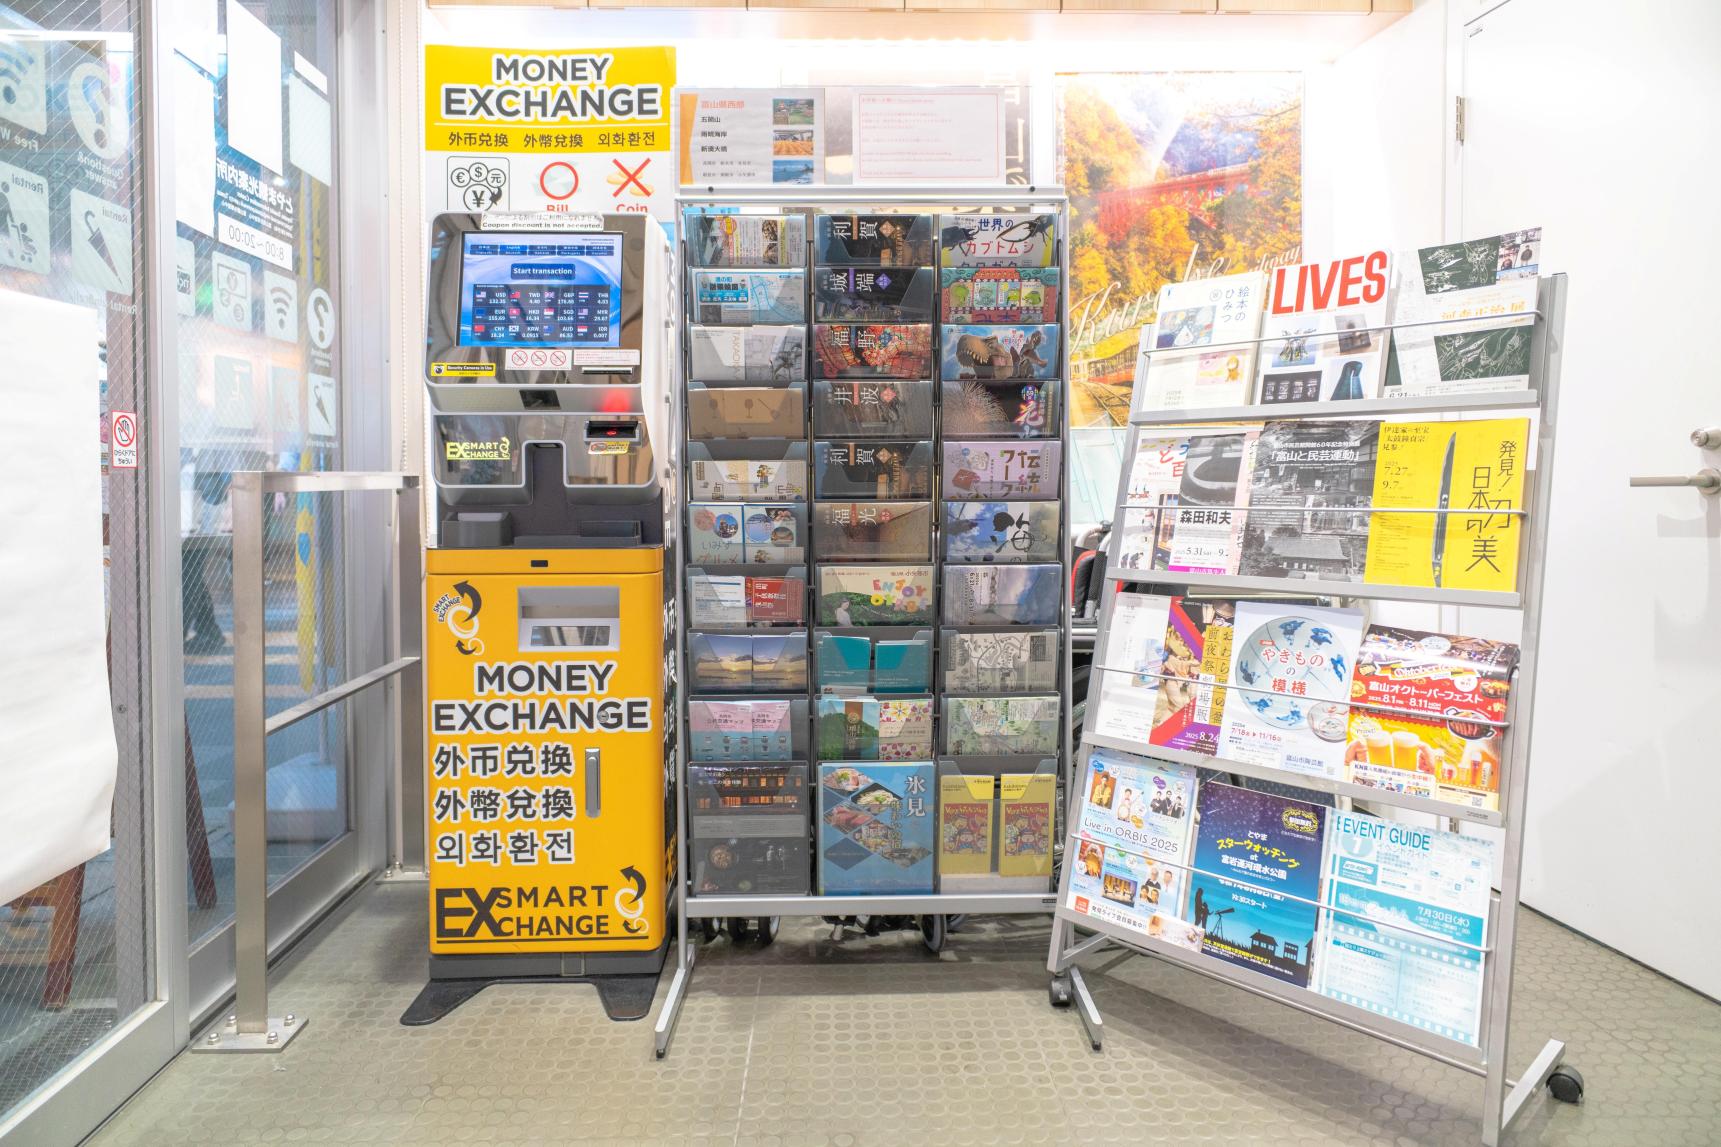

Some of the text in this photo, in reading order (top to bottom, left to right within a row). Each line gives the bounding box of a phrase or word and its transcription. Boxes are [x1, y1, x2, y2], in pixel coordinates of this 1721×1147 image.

[496, 58, 609, 82] MONEY
[444, 87, 659, 117] EXCHANGE
[448, 132, 508, 147] 外币兑换
[598, 131, 656, 147] 외화환전
[978, 218, 1014, 232] 世界の
[966, 242, 1034, 254] カブトムシ
[1272, 250, 1388, 314] LIVES
[1221, 289, 1234, 323] ひみつ
[1235, 286, 1250, 322] 絵本の
[464, 442, 498, 450] SMART
[1271, 450, 1360, 462] 「富山と民芸運動」
[1180, 510, 1232, 525] 森田和夫
[433, 594, 450, 612] SMART
[1204, 628, 1218, 672] 前夜祭
[1263, 648, 1324, 666] やきもの
[477, 664, 614, 693] MONEY
[1286, 666, 1296, 676] の
[1272, 678, 1308, 696] 模様
[1368, 680, 1484, 704] 富山オクトーバーフェスト
[434, 701, 649, 731] EXCHANGE
[435, 745, 572, 776] 外币兑换
[435, 789, 573, 821] 外幣兌換
[905, 776, 926, 818] 氷見
[1084, 818, 1178, 853] Live in ORBIS 2025
[1248, 830, 1268, 841] とやま
[1344, 818, 1386, 840] EVENT
[1389, 828, 1431, 851] GUIDE
[436, 831, 573, 864] 외화환전
[1216, 838, 1300, 868] スターウォッチング
[498, 885, 610, 908] SMART
[498, 914, 610, 937] CHANGE
